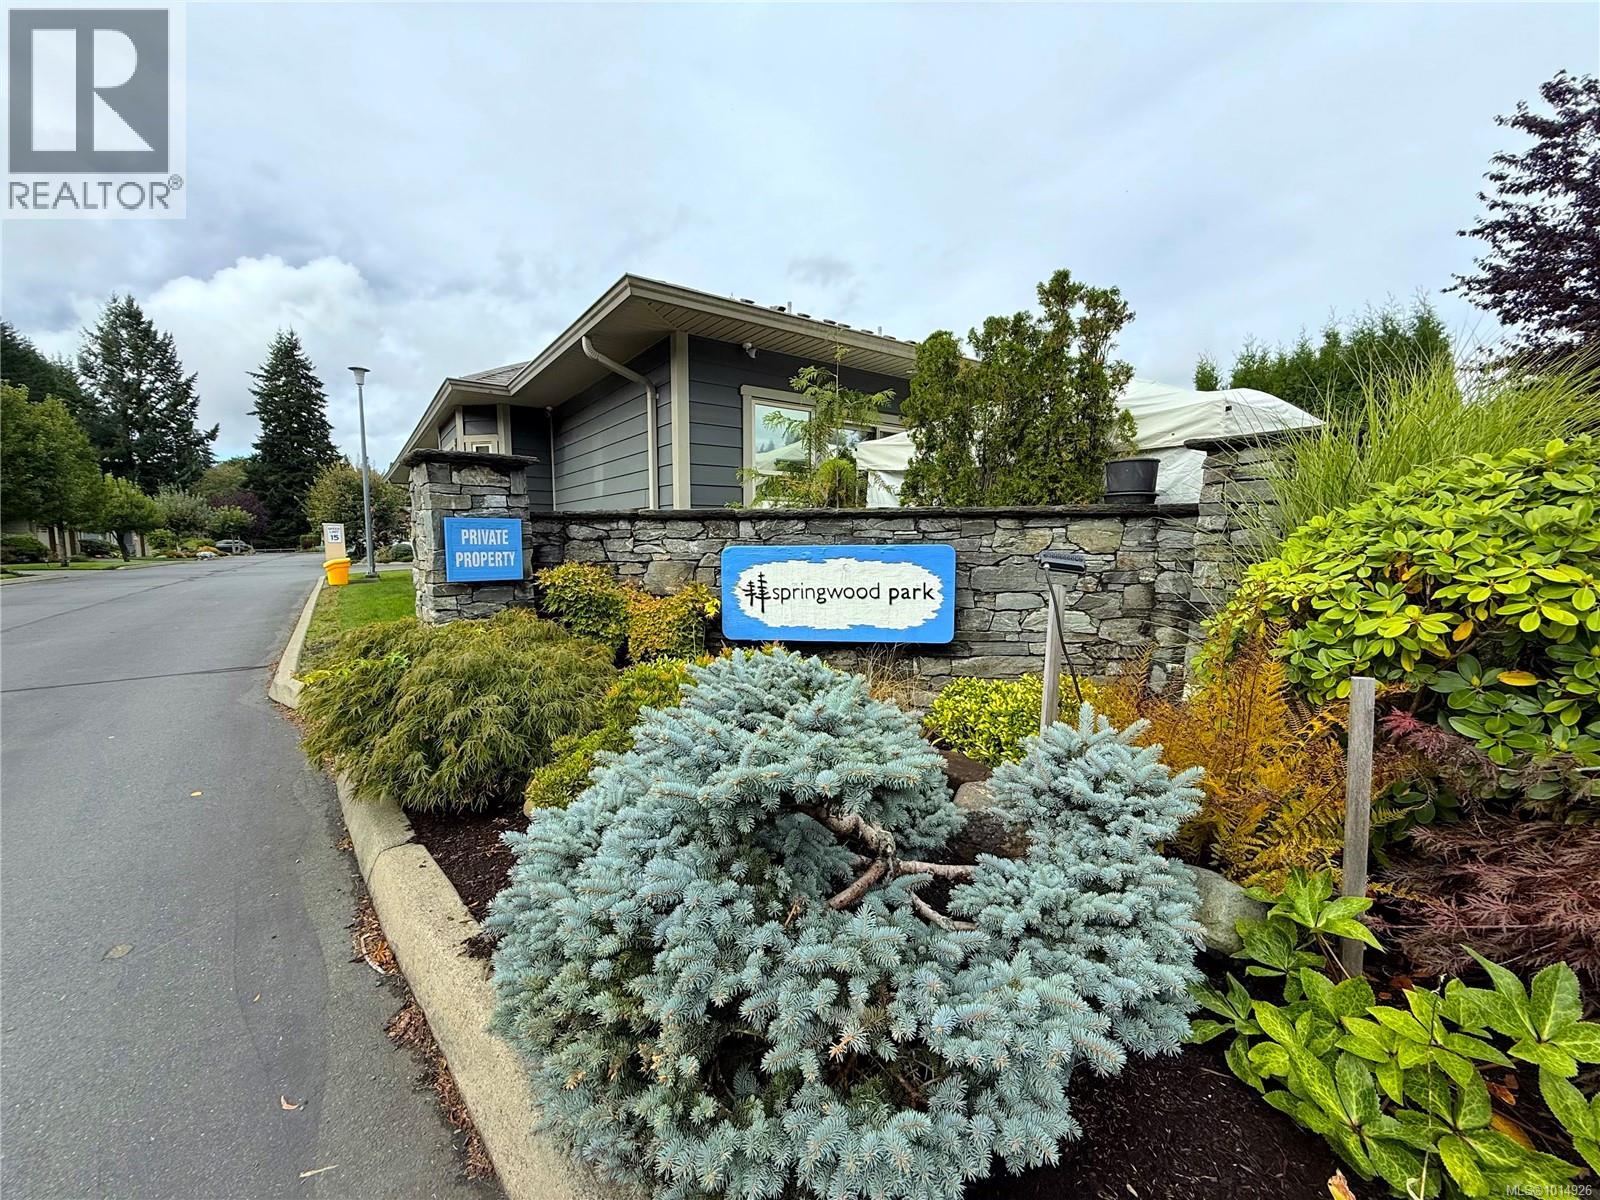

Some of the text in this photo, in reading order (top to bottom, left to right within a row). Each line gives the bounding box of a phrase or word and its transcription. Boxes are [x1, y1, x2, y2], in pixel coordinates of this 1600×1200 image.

[461, 529, 509, 545] PRIVATE
[455, 551, 516, 568] PROPERTY
[772, 582, 935, 605] springwood park
